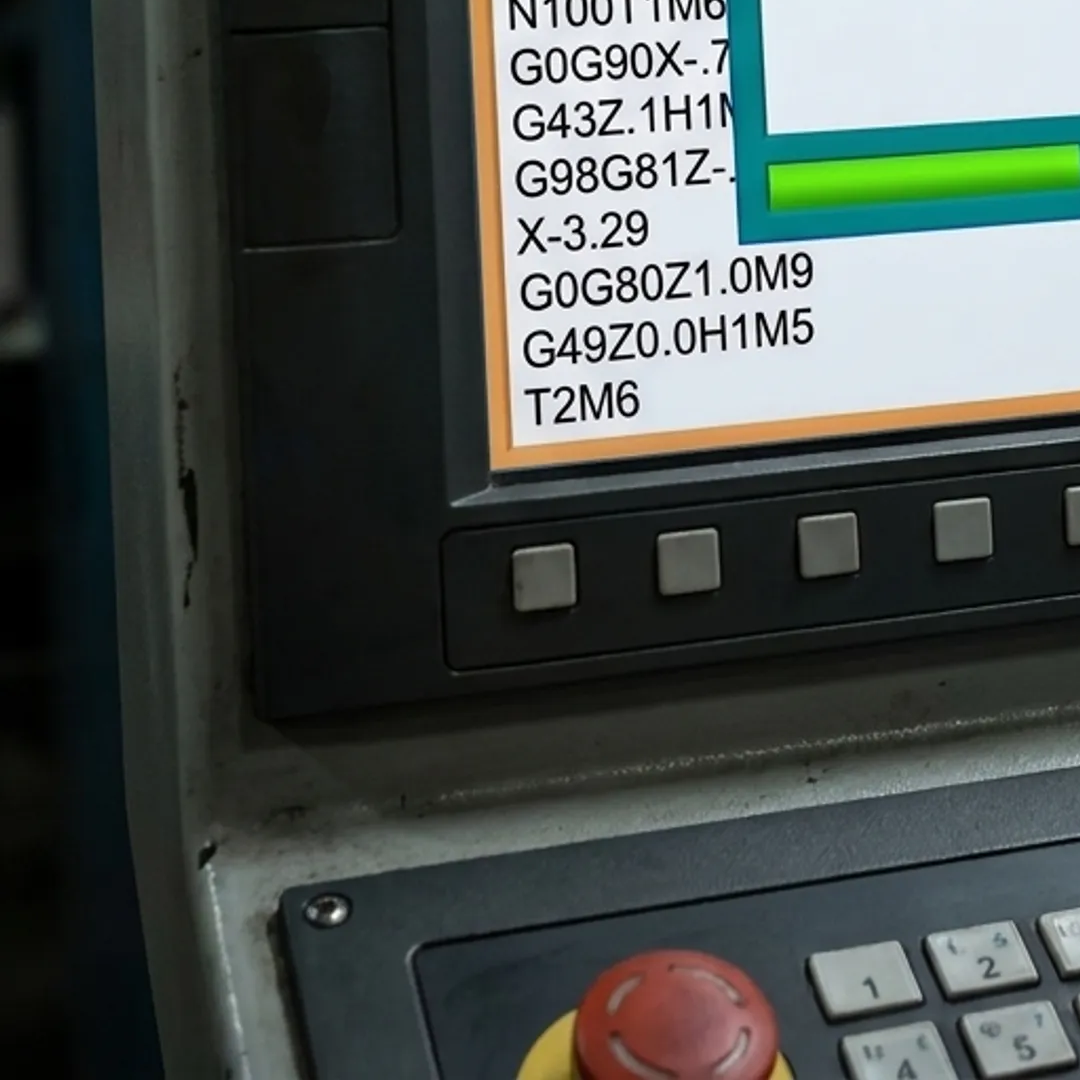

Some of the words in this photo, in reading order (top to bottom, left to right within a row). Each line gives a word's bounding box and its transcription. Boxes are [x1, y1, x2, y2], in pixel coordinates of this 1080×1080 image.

[510, 39, 730, 85] G0G90X-.7
[515, 148, 737, 198] G98G81Z-.
[518, 210, 649, 255] X-3.29
[520, 252, 814, 311] G0G80Z1.0M9
[523, 307, 814, 369] G49Z0.0H1M5
[524, 380, 640, 426] T2M6
[862, 976, 879, 1000] 1
[977, 956, 1001, 979] 2
[1013, 1035, 1036, 1061] 5
